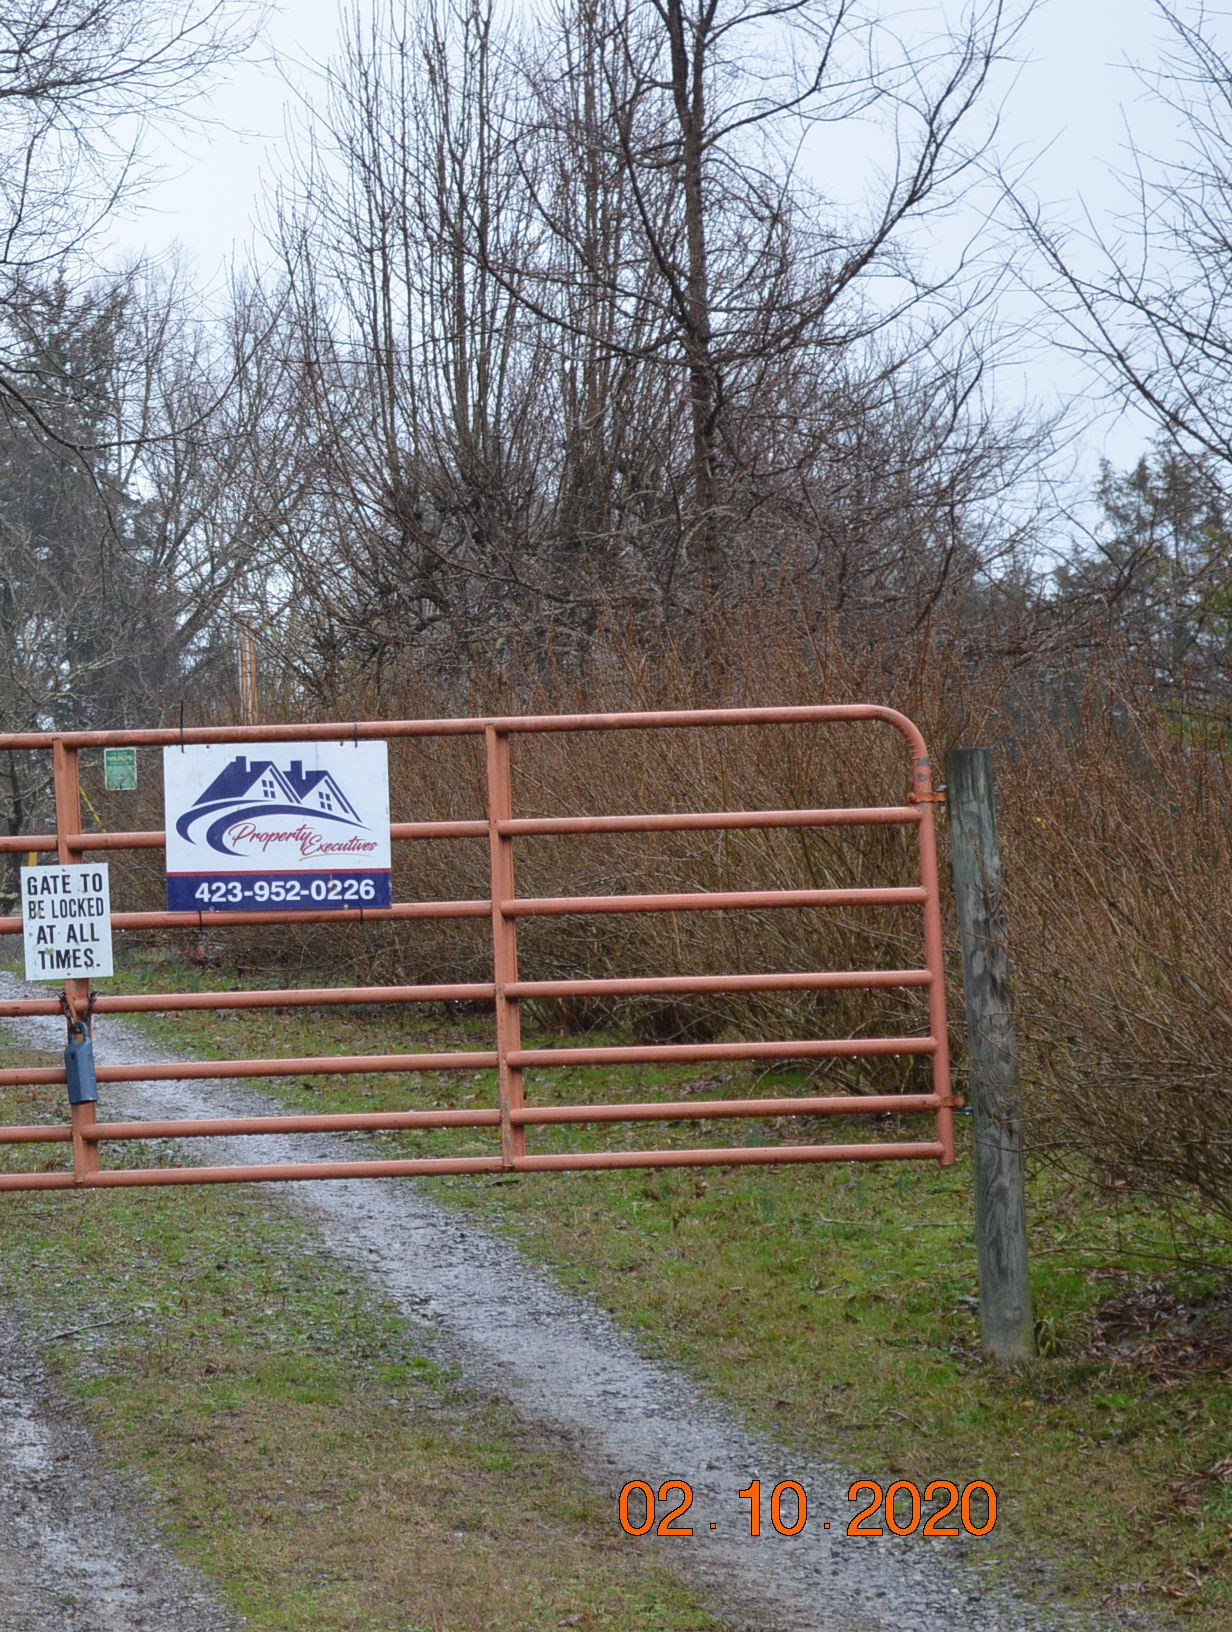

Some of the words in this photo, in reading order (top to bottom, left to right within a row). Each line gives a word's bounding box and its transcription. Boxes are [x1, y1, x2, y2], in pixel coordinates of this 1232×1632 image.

[227, 822, 314, 851] Property
[301, 834, 379, 857] Executives
[27, 874, 72, 896] GATE
[80, 872, 103, 893] TO
[195, 879, 376, 902] 423-952-0226
[28, 900, 45, 919] BE
[51, 897, 104, 918] LOCKED
[36, 924, 56, 944] AT
[66, 922, 100, 943] ALL
[37, 947, 100, 970] TIMES.
